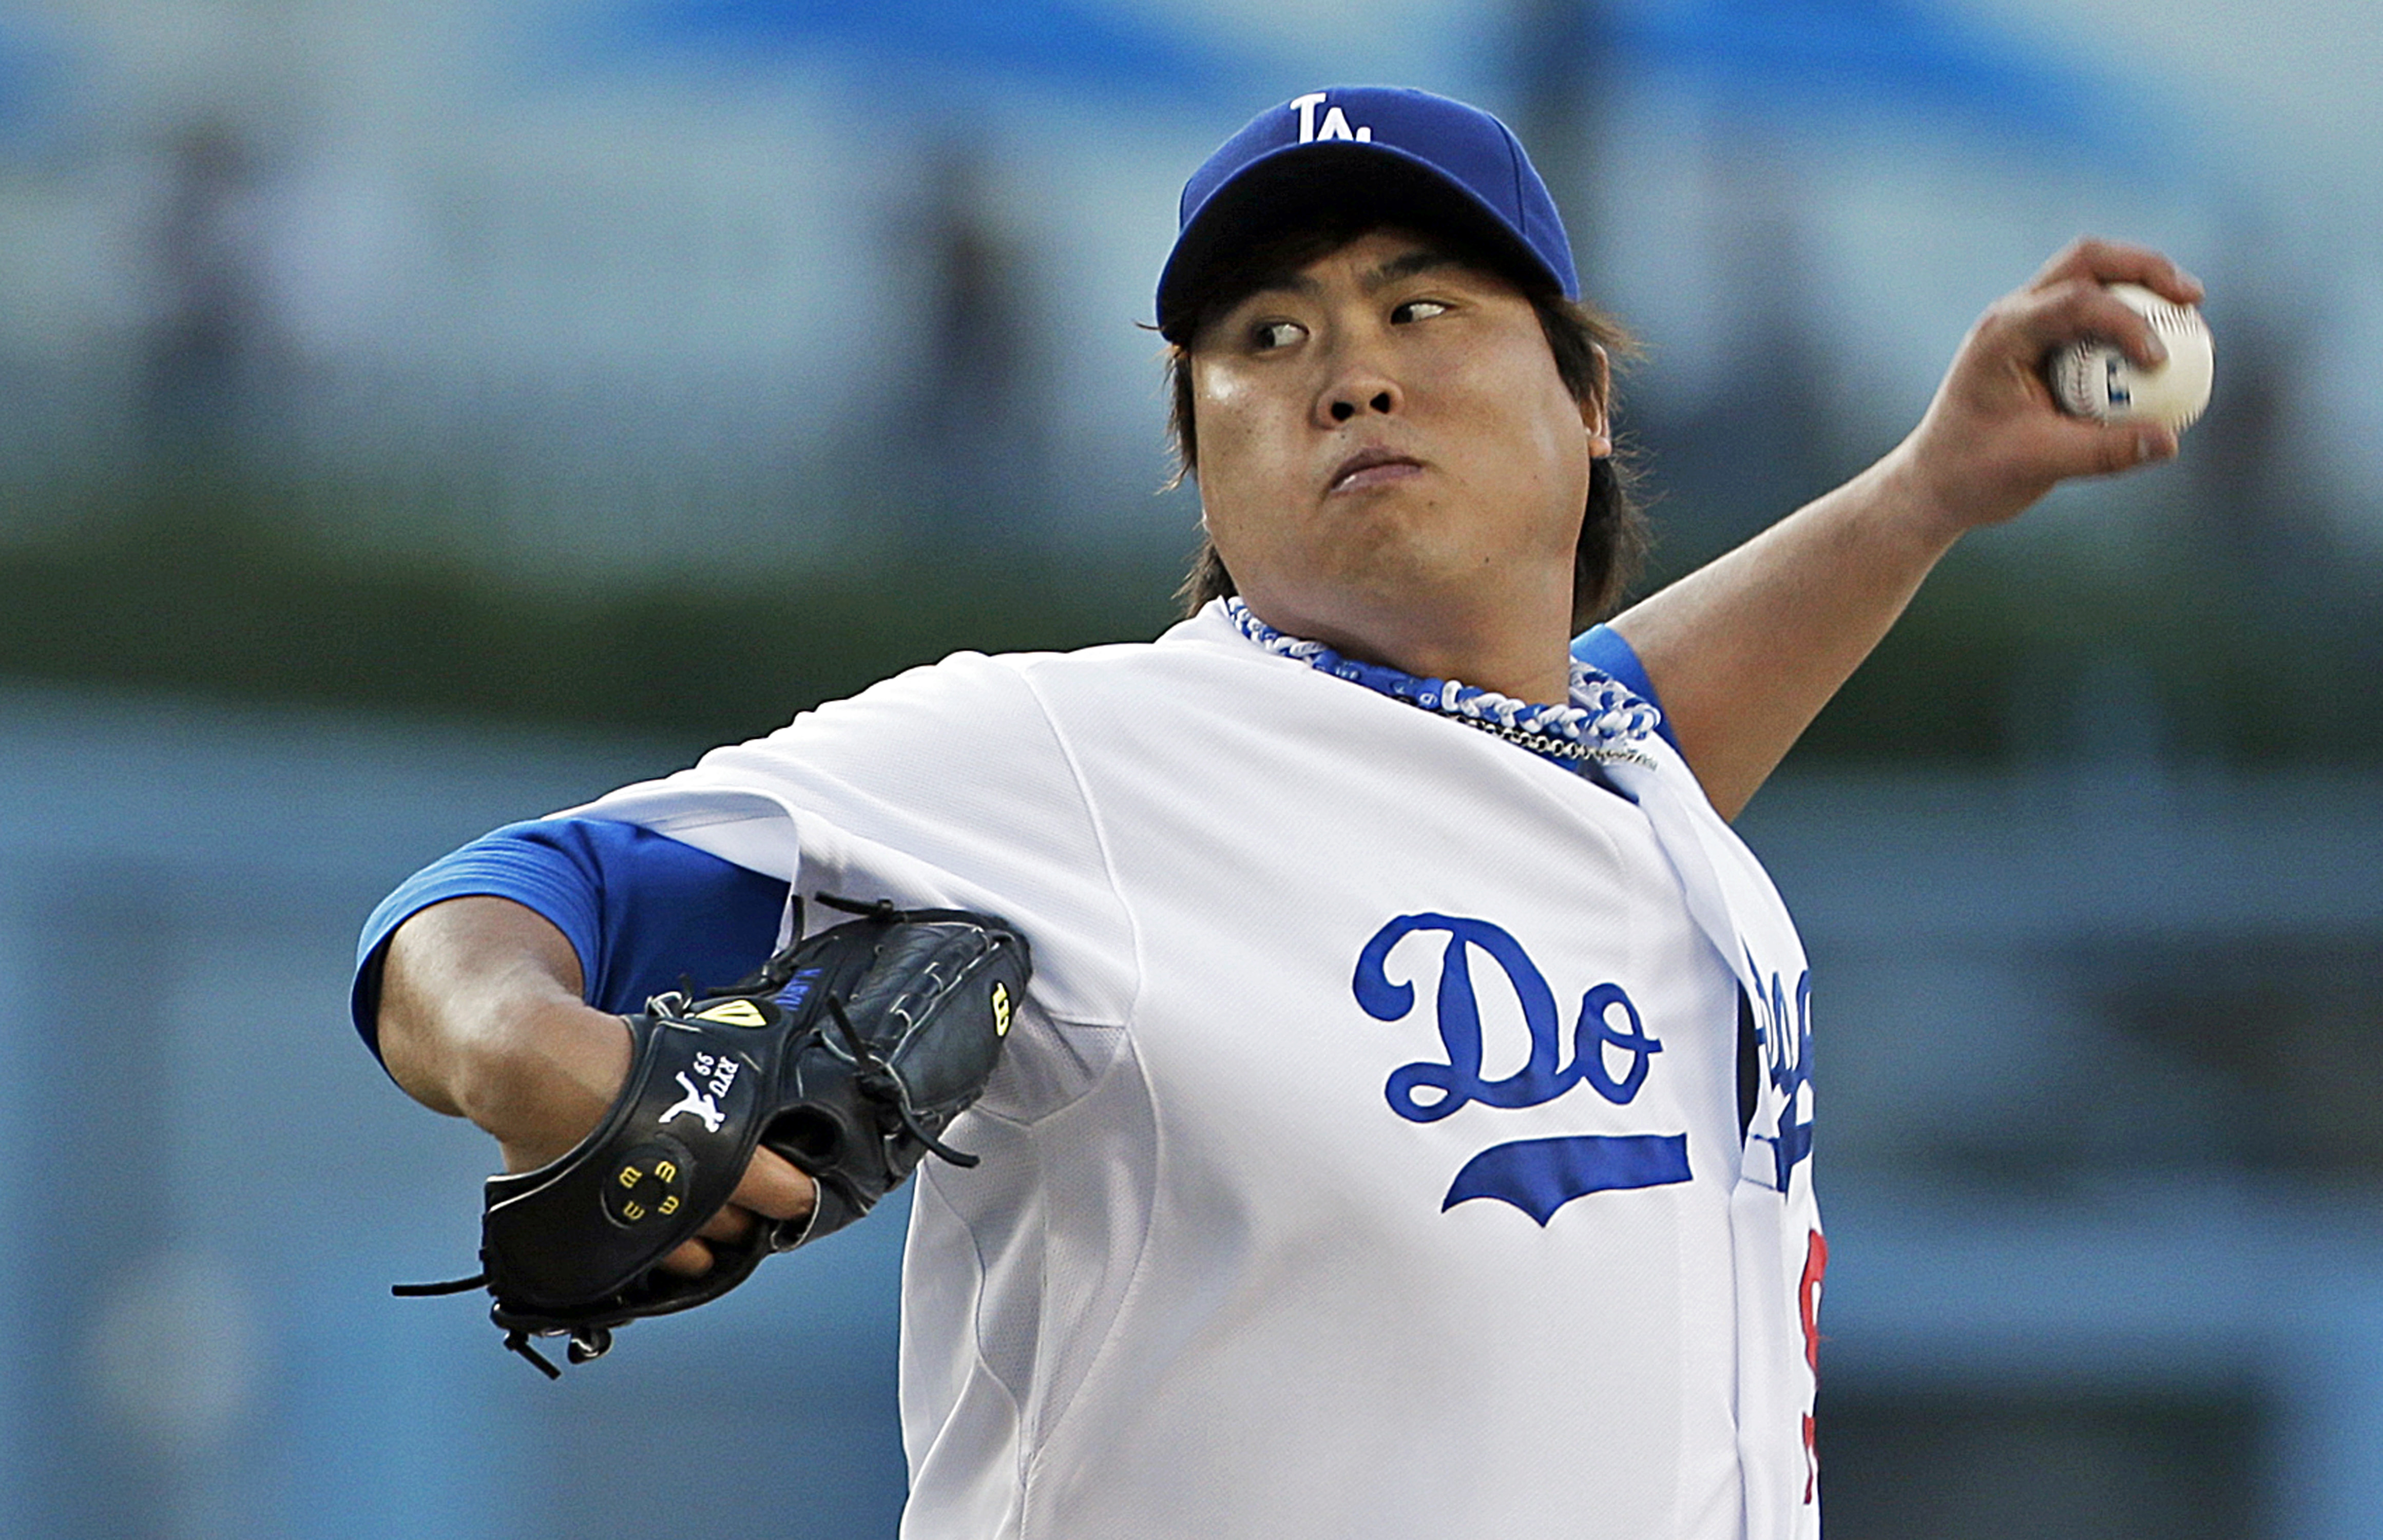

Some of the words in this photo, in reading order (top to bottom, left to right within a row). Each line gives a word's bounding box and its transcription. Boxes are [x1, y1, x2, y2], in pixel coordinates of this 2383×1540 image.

[1352, 912, 1664, 1123] Do
[694, 1051, 715, 1076] 99
[709, 1056, 740, 1099] RYU
